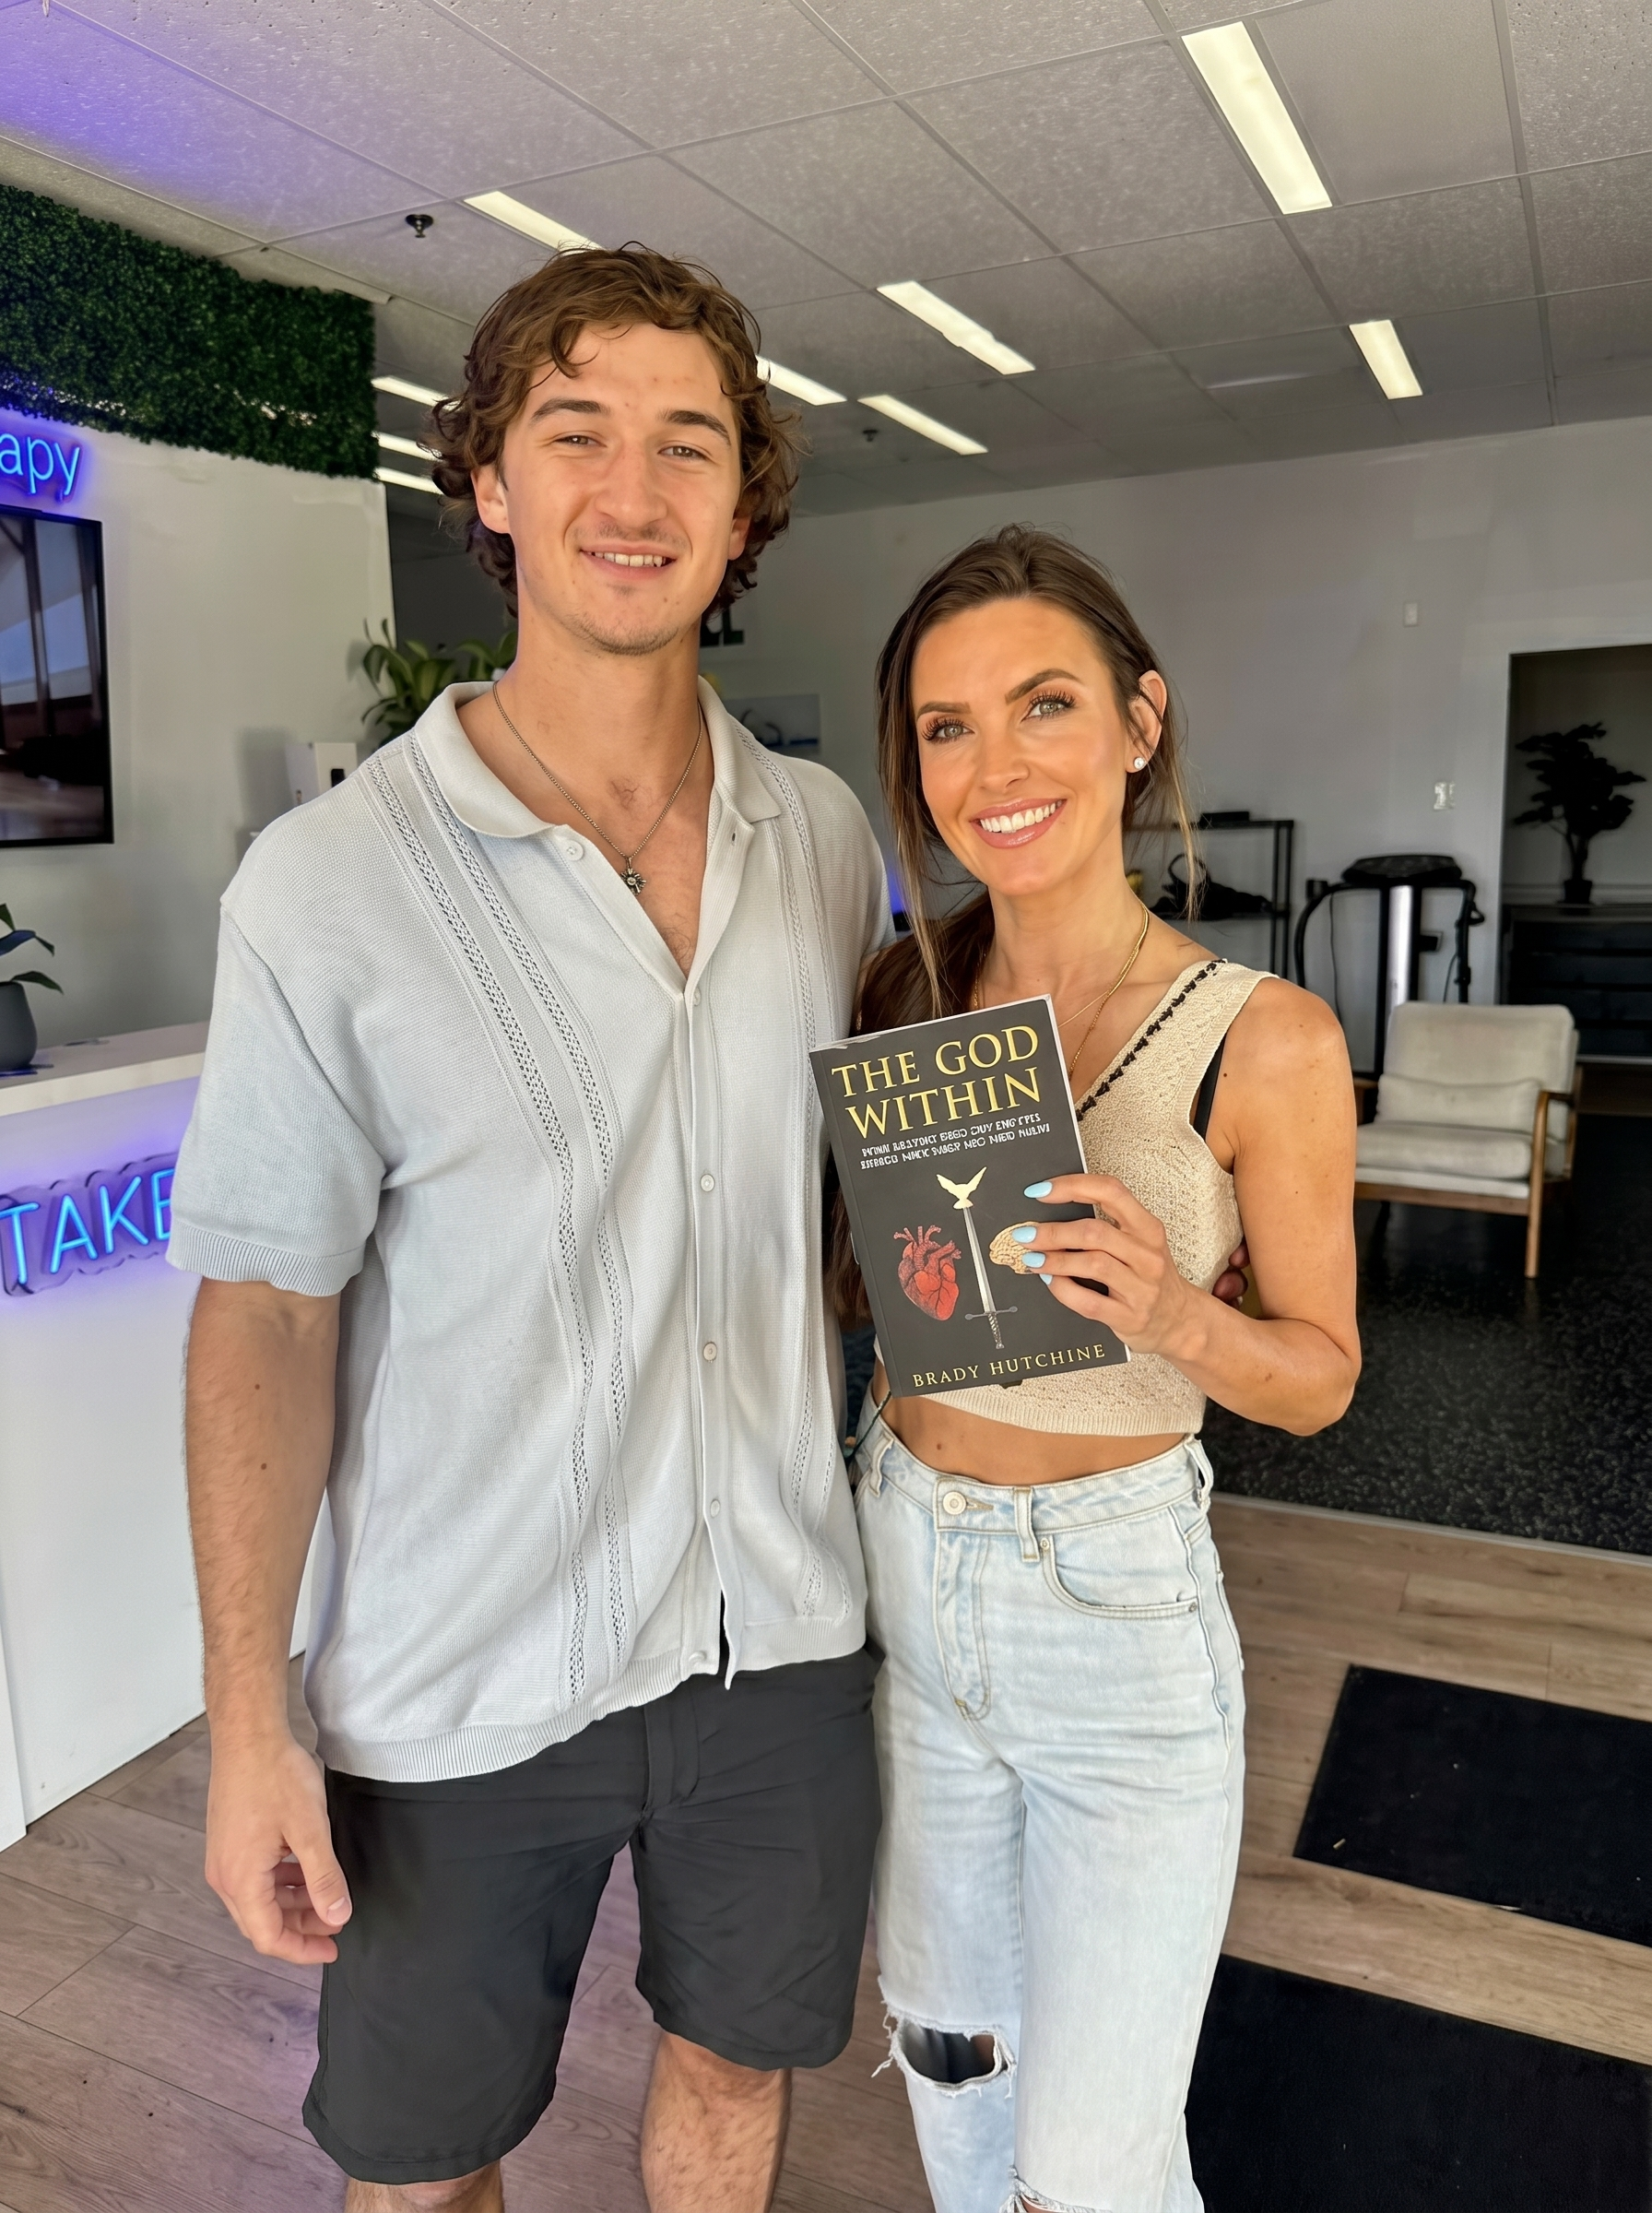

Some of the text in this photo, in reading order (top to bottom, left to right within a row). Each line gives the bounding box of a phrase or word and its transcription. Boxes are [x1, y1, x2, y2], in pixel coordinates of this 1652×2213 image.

[0, 433, 80, 496] apy
[831, 1025, 1039, 1098] THE GOD
[844, 1066, 1041, 1140] WITHIN
[0, 1167, 175, 1284] TAKE
[912, 1343, 1105, 1388] BRADY HUTCHINE
